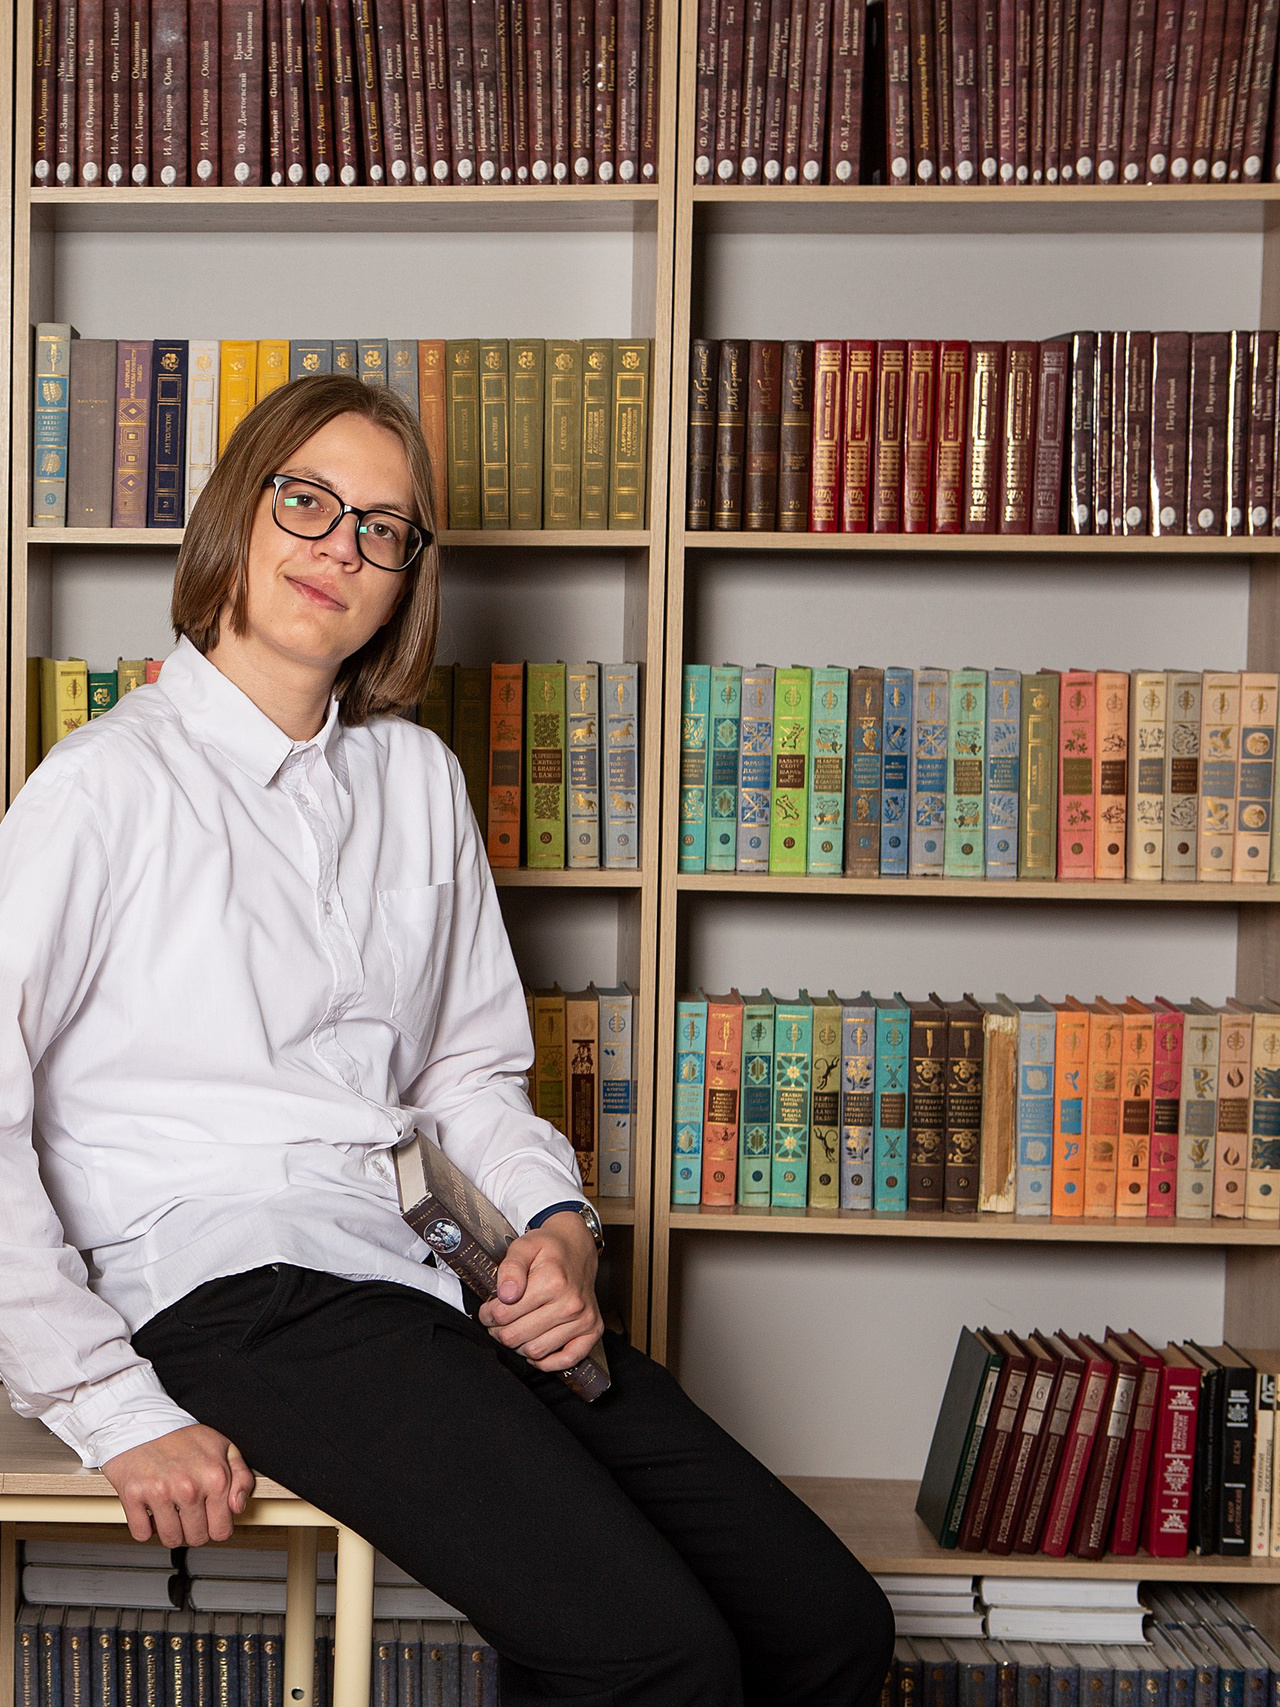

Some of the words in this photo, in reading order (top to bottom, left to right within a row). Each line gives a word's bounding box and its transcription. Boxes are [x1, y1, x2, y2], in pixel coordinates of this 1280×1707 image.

[67, 7, 75, 44] Рассказы
[246, 11, 254, 60] Карамазовы
[410, 4, 418, 40] Рассказы
[86, 40, 94, 65] Пьесы
[234, 32, 243, 60] Братья
[270, 41, 278, 72] Гордеев
[412, 46, 420, 79] Повести
[534, 50, 542, 70] детей
[66, 49, 75, 82] Повести
[111, 53, 120, 82] Фрегат
[238, 73, 248, 125] Достоевский
[270, 74, 278, 97] Фома
[60, 94, 69, 129] Замятин
[86, 79, 95, 127] Островский
[111, 93, 120, 130] Гончаров
[414, 92, 423, 132] Платонов
[271, 110, 280, 143] Горький
[535, 121, 543, 150] Русские
[723, 499, 733, 509] 21
